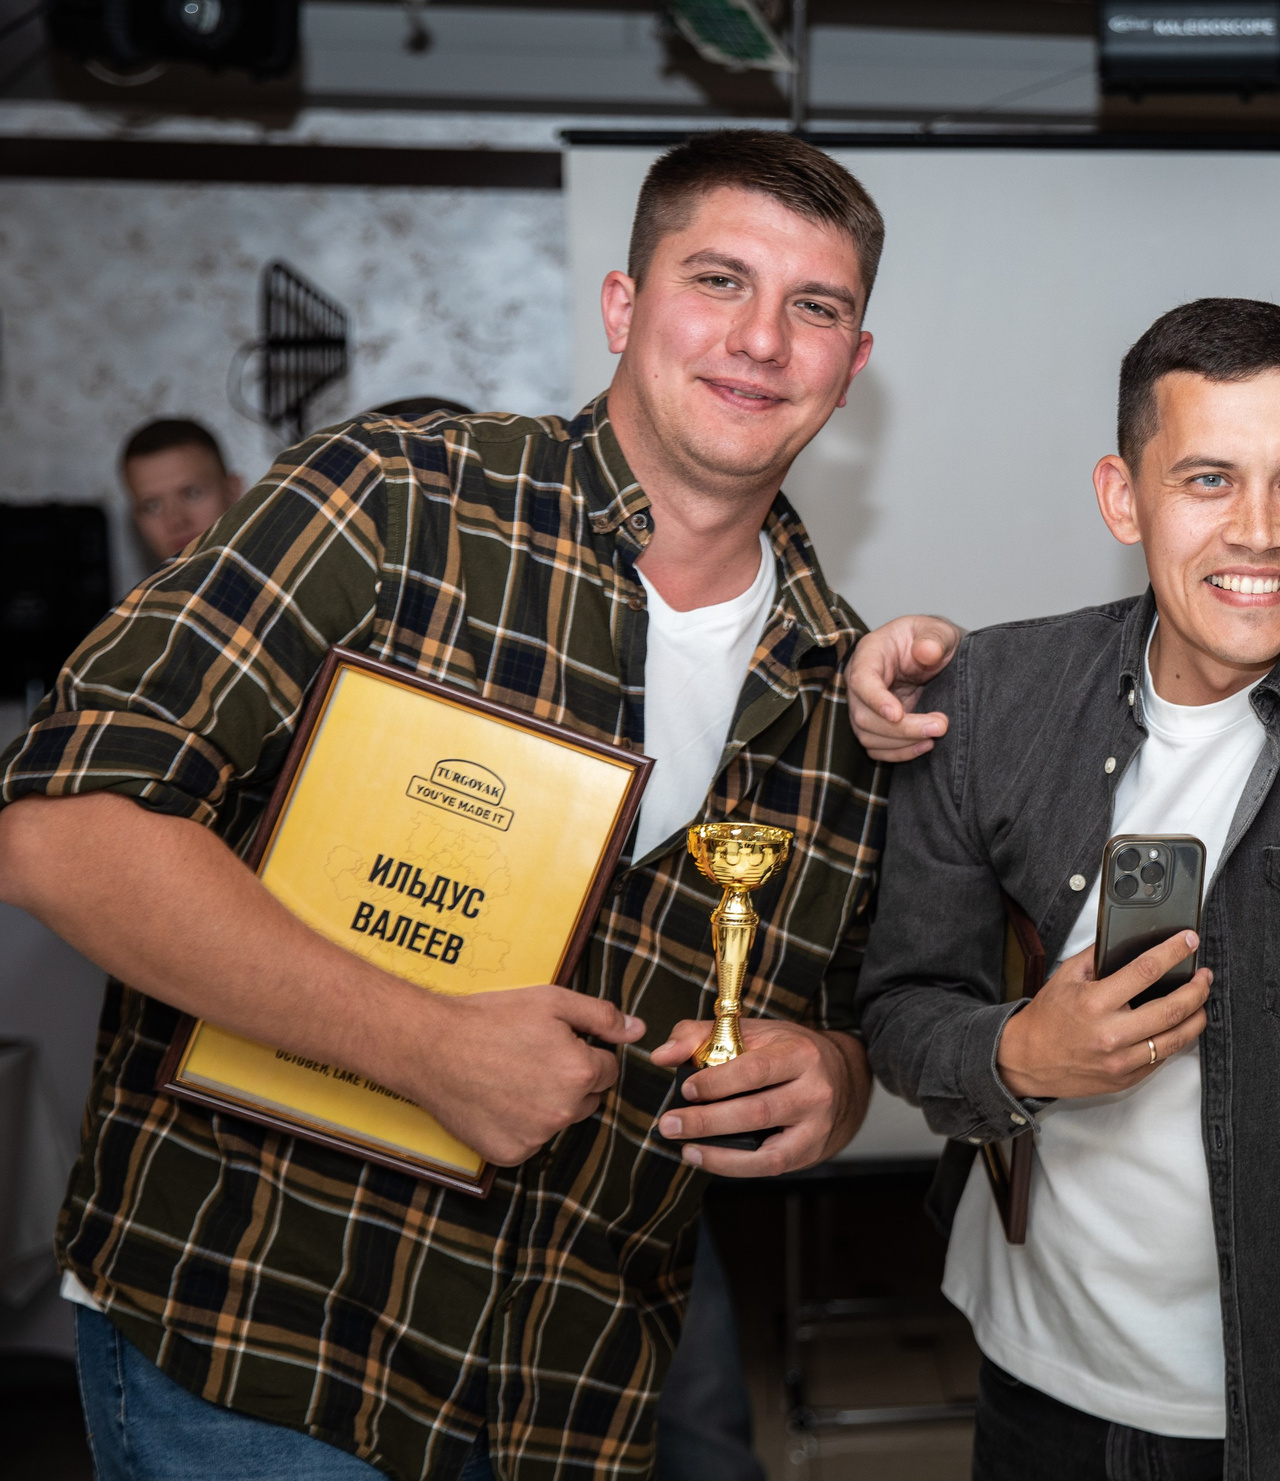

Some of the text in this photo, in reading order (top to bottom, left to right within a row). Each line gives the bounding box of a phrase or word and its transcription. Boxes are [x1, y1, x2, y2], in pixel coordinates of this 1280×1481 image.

[437, 766, 502, 798] TURGOYAK
[416, 784, 506, 825] YOU'VE MADE IT
[367, 853, 486, 920] ИЛЬДУС
[349, 900, 465, 966] ВАЛЕЕВ
[332, 1066, 361, 1087] LAKE
